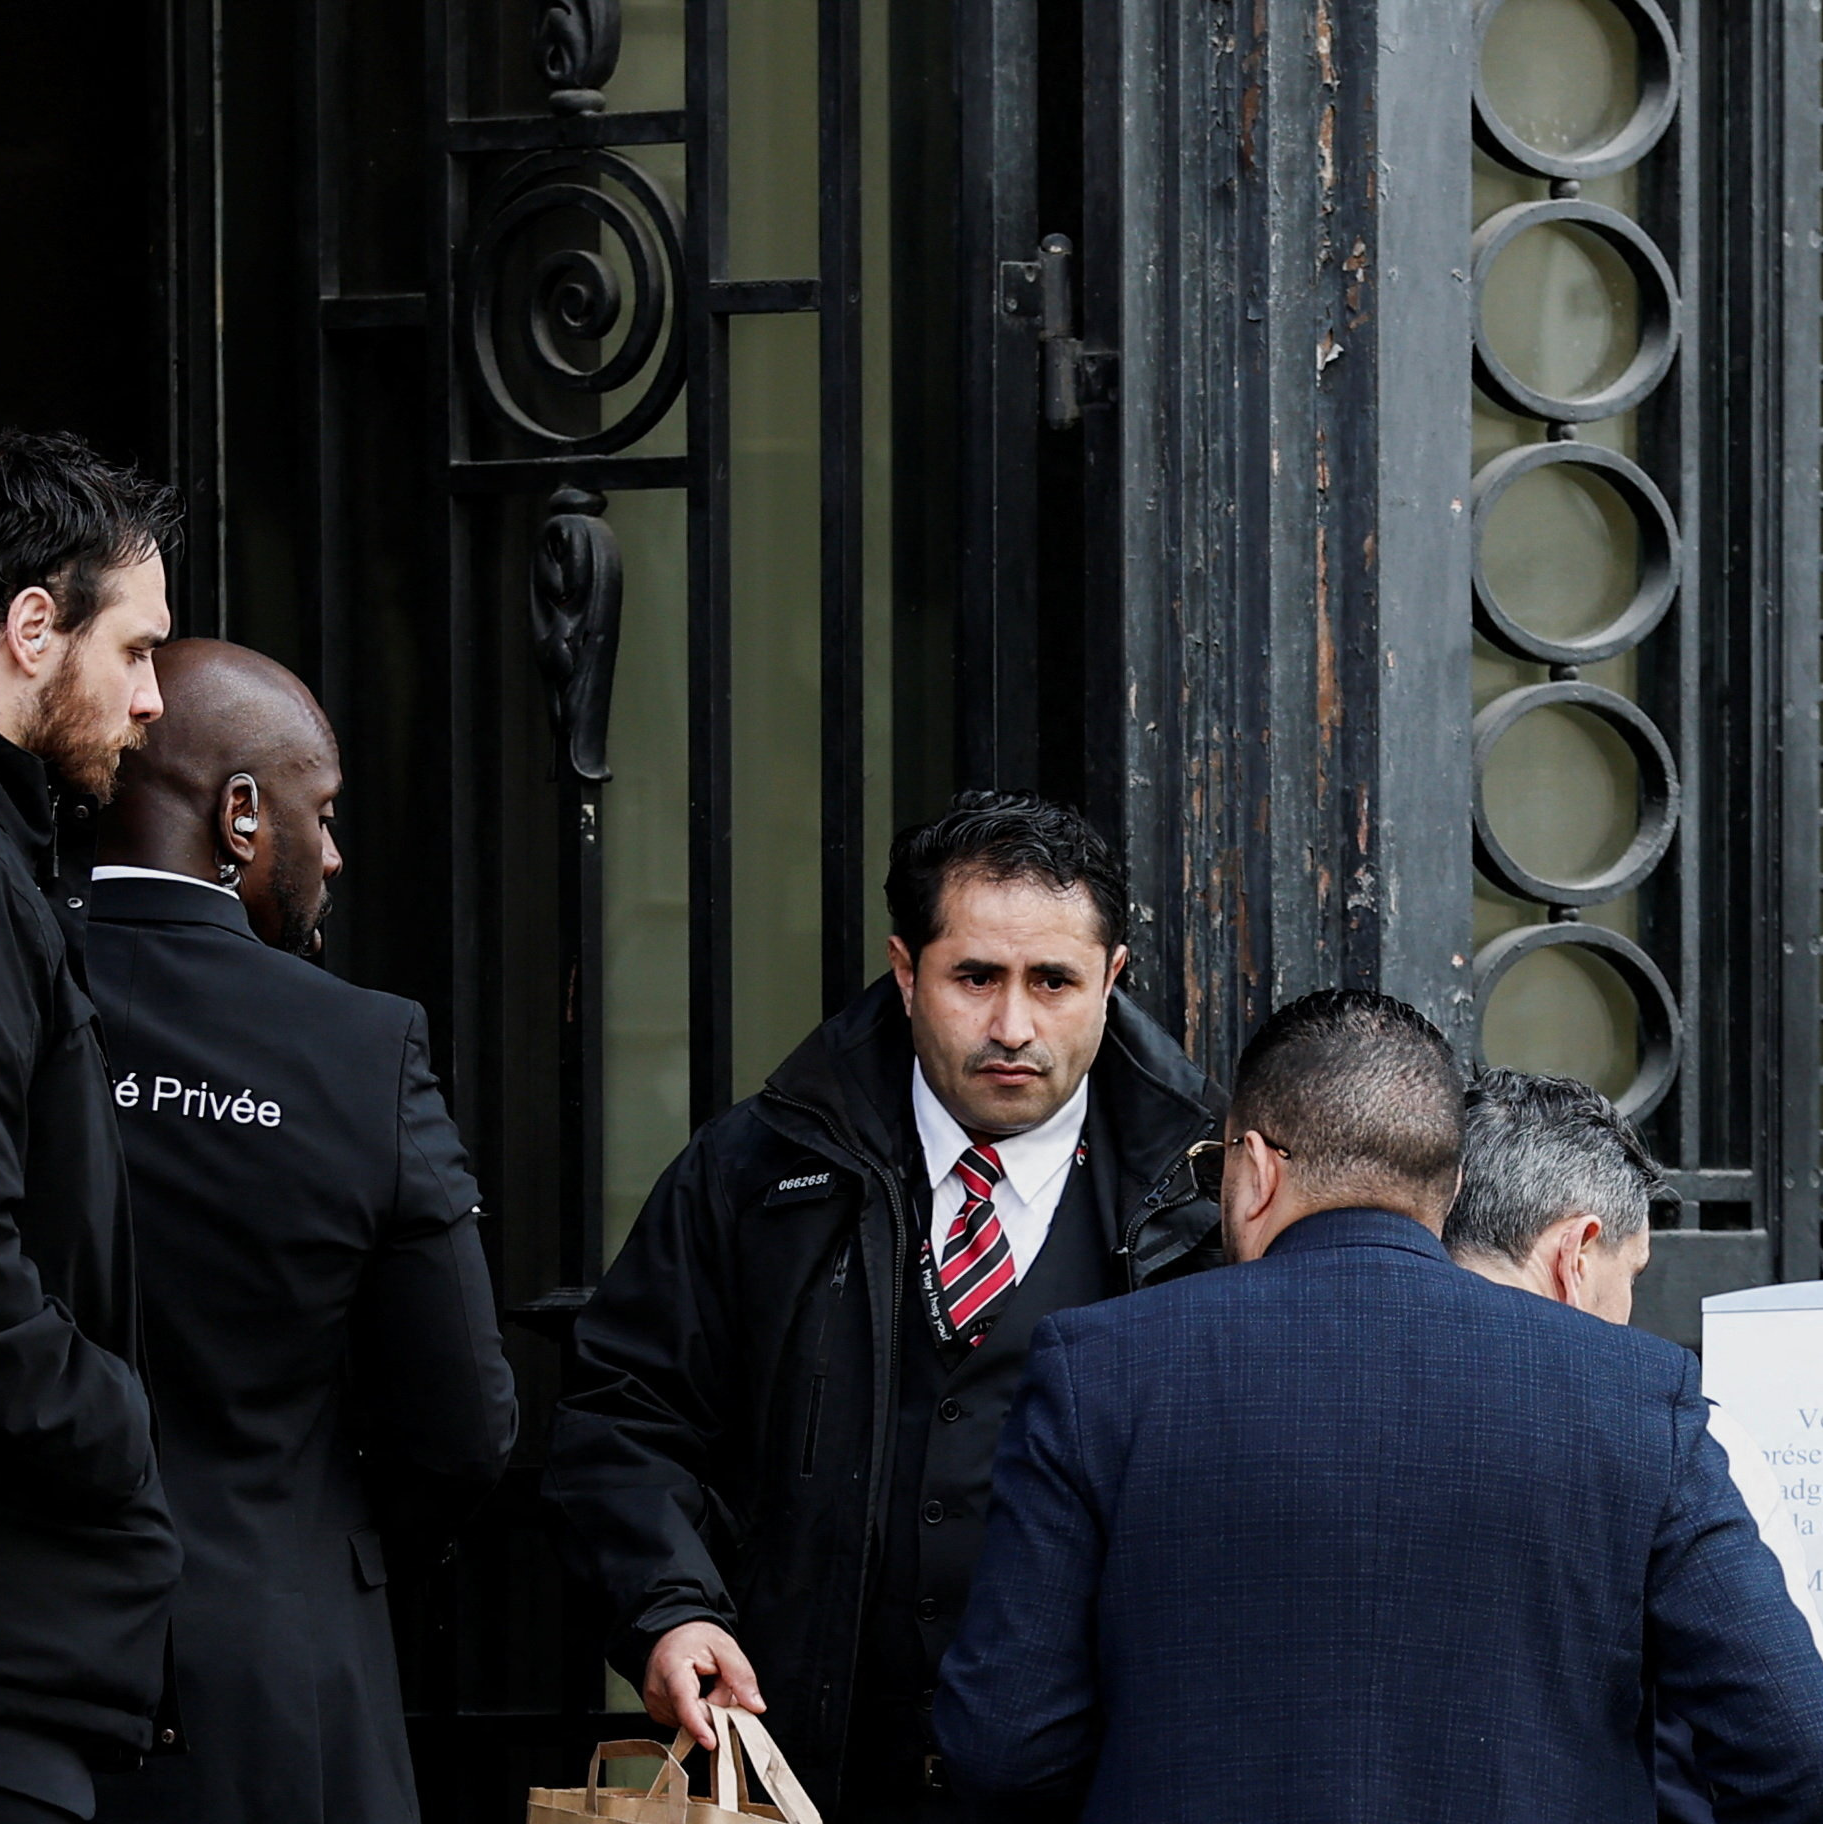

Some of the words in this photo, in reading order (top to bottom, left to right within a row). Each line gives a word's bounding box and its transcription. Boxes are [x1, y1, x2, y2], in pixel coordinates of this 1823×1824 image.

[112, 1072, 140, 1107] é
[152, 1076, 281, 1127] Privée
[922, 1268, 934, 1290] May
[933, 1318, 952, 1341] you?
